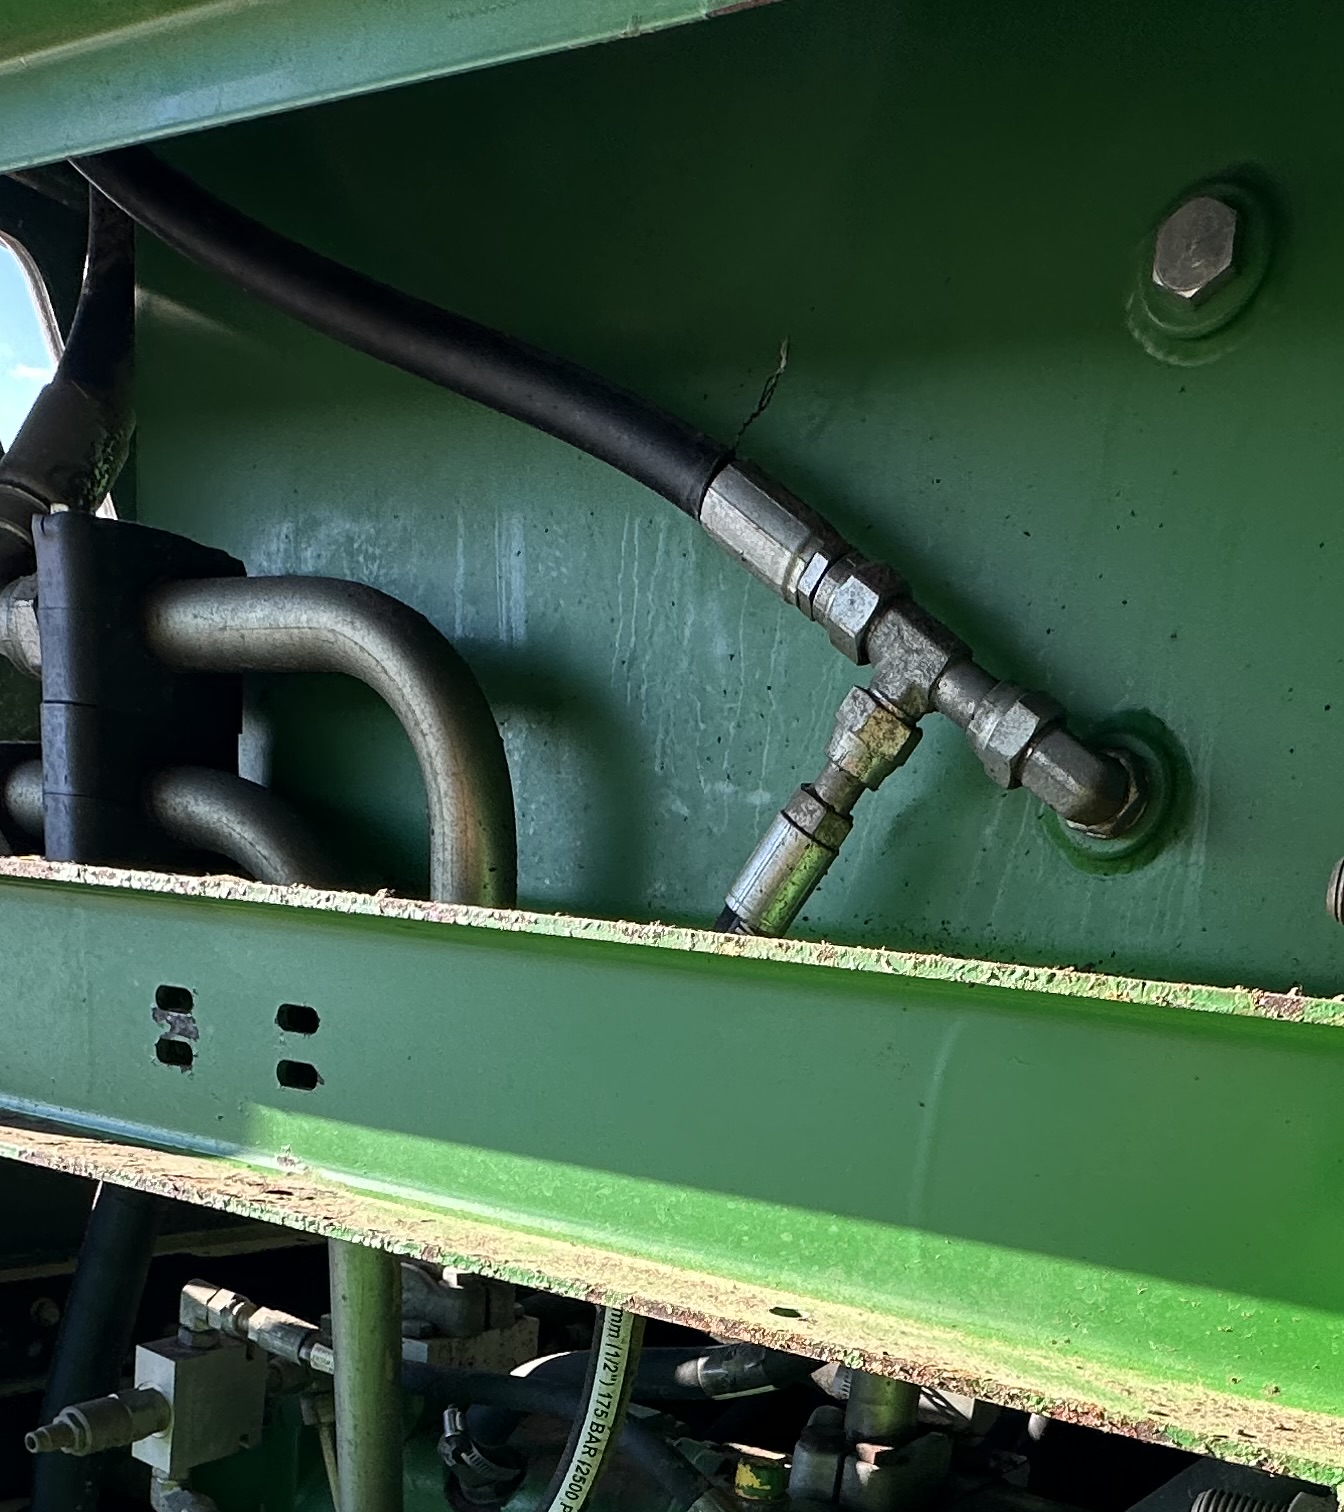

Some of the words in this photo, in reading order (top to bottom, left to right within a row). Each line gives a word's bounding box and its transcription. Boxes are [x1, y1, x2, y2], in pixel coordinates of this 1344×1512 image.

[598, 1342, 624, 1386] (1/2")
[593, 1392, 613, 1419] 175
[581, 1420, 606, 1458] BAR
[565, 1459, 593, 1501] (2500
